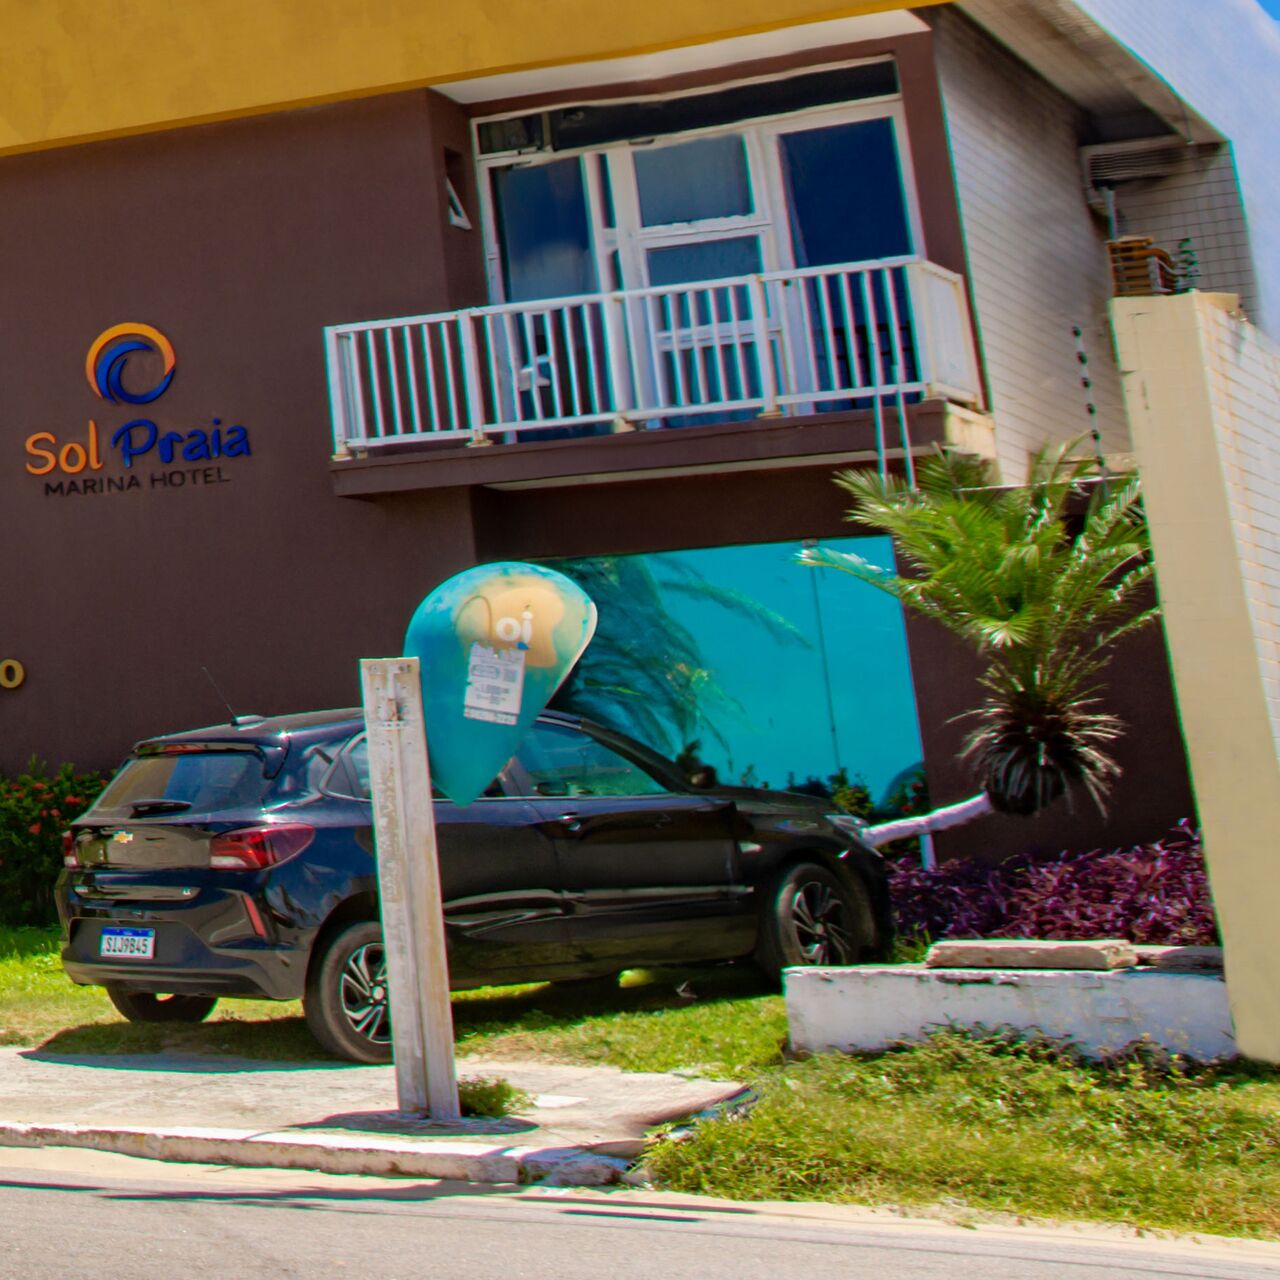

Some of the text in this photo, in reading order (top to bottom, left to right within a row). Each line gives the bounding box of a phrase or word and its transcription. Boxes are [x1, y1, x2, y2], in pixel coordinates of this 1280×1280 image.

[25, 418, 251, 475] Sol Praia
[44, 467, 231, 496] MARINA HOTEL
[496, 611, 532, 643] oi
